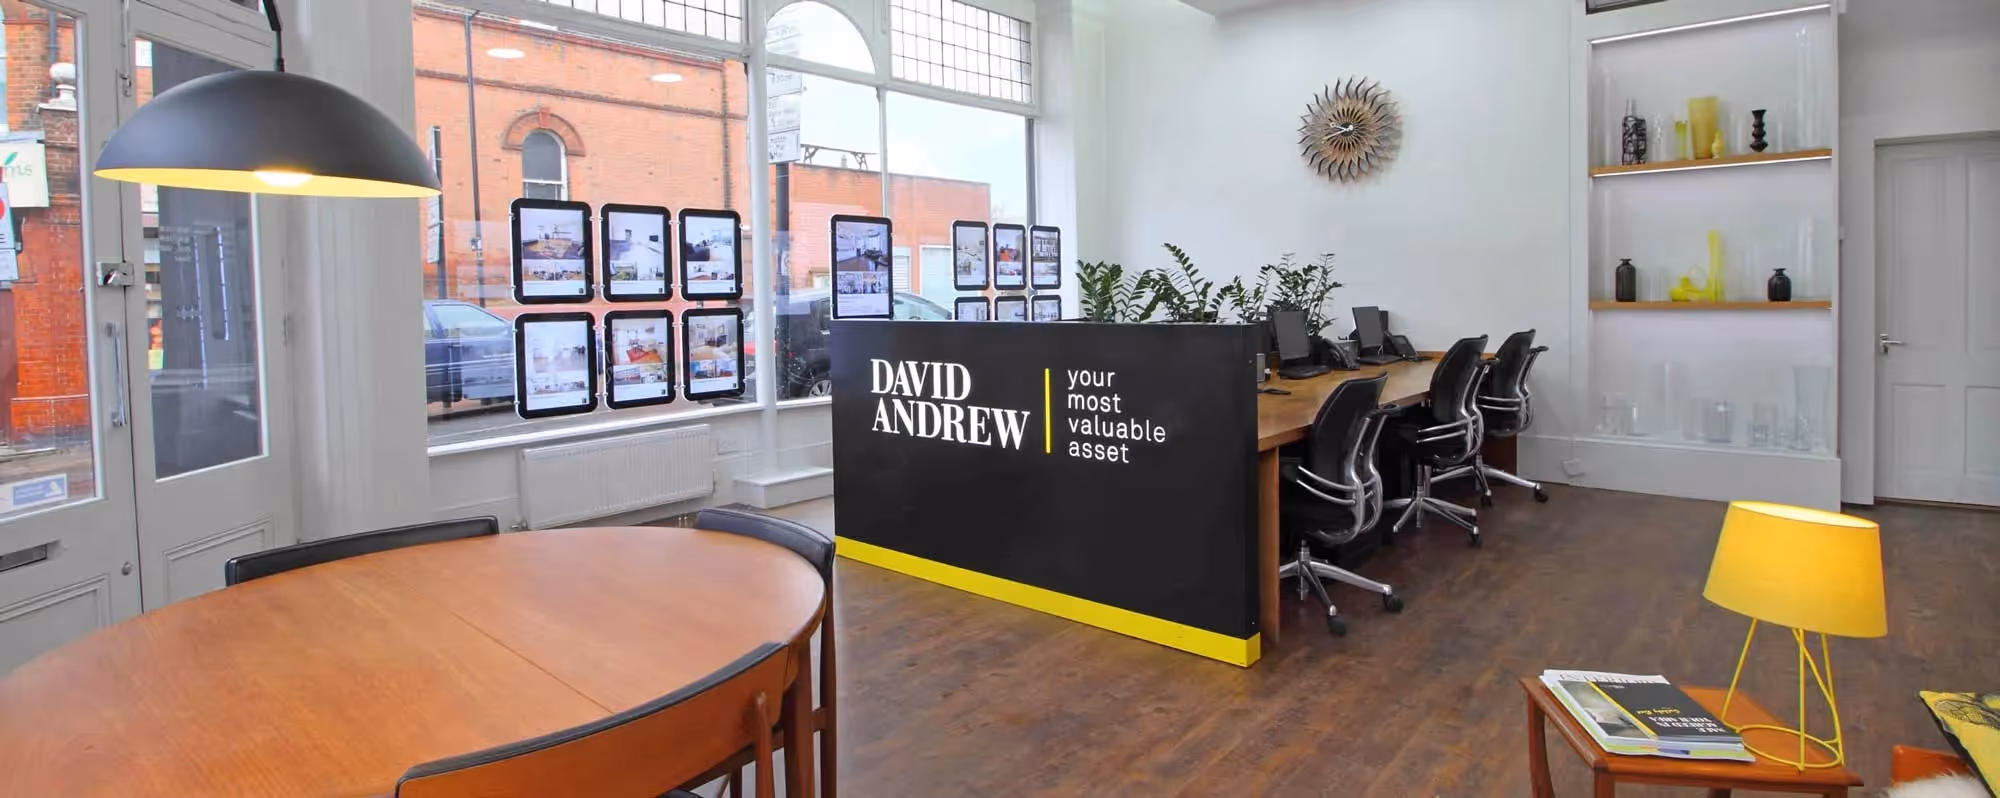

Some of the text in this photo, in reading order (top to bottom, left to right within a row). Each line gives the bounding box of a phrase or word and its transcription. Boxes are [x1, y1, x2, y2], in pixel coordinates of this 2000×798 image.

[870, 358, 972, 401] DAVID
[1067, 369, 1116, 390] your
[1067, 391, 1122, 414] most
[871, 396, 1031, 450] ANDREW
[1067, 415, 1167, 444] valuable
[1068, 440, 1130, 464] asset
